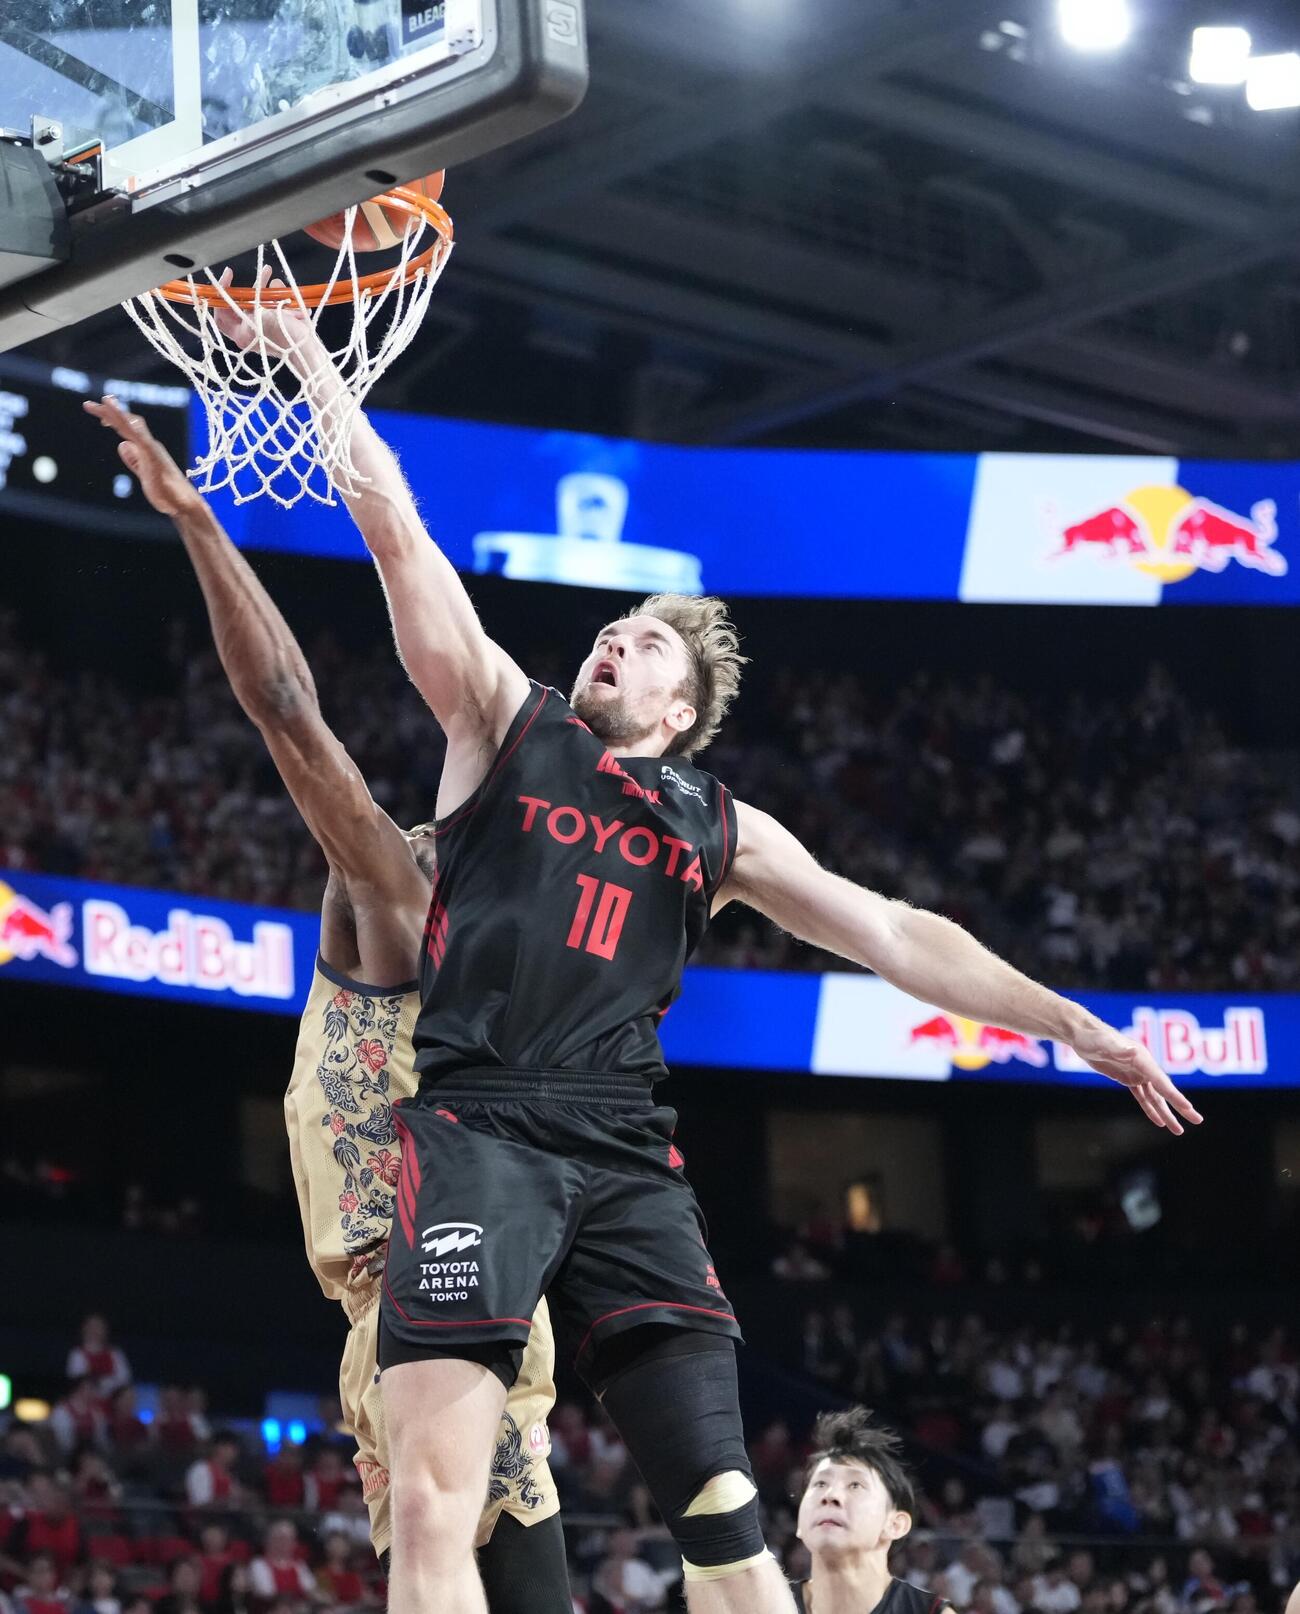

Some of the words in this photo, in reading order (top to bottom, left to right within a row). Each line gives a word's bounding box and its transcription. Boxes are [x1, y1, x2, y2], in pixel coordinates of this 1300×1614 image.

[518, 795, 704, 893] TOYOTA
[566, 872, 633, 961] 10
[420, 1261, 479, 1275] TOYOTA
[418, 1275, 478, 1290] ARENA
[430, 1291, 468, 1302] TOKYO
